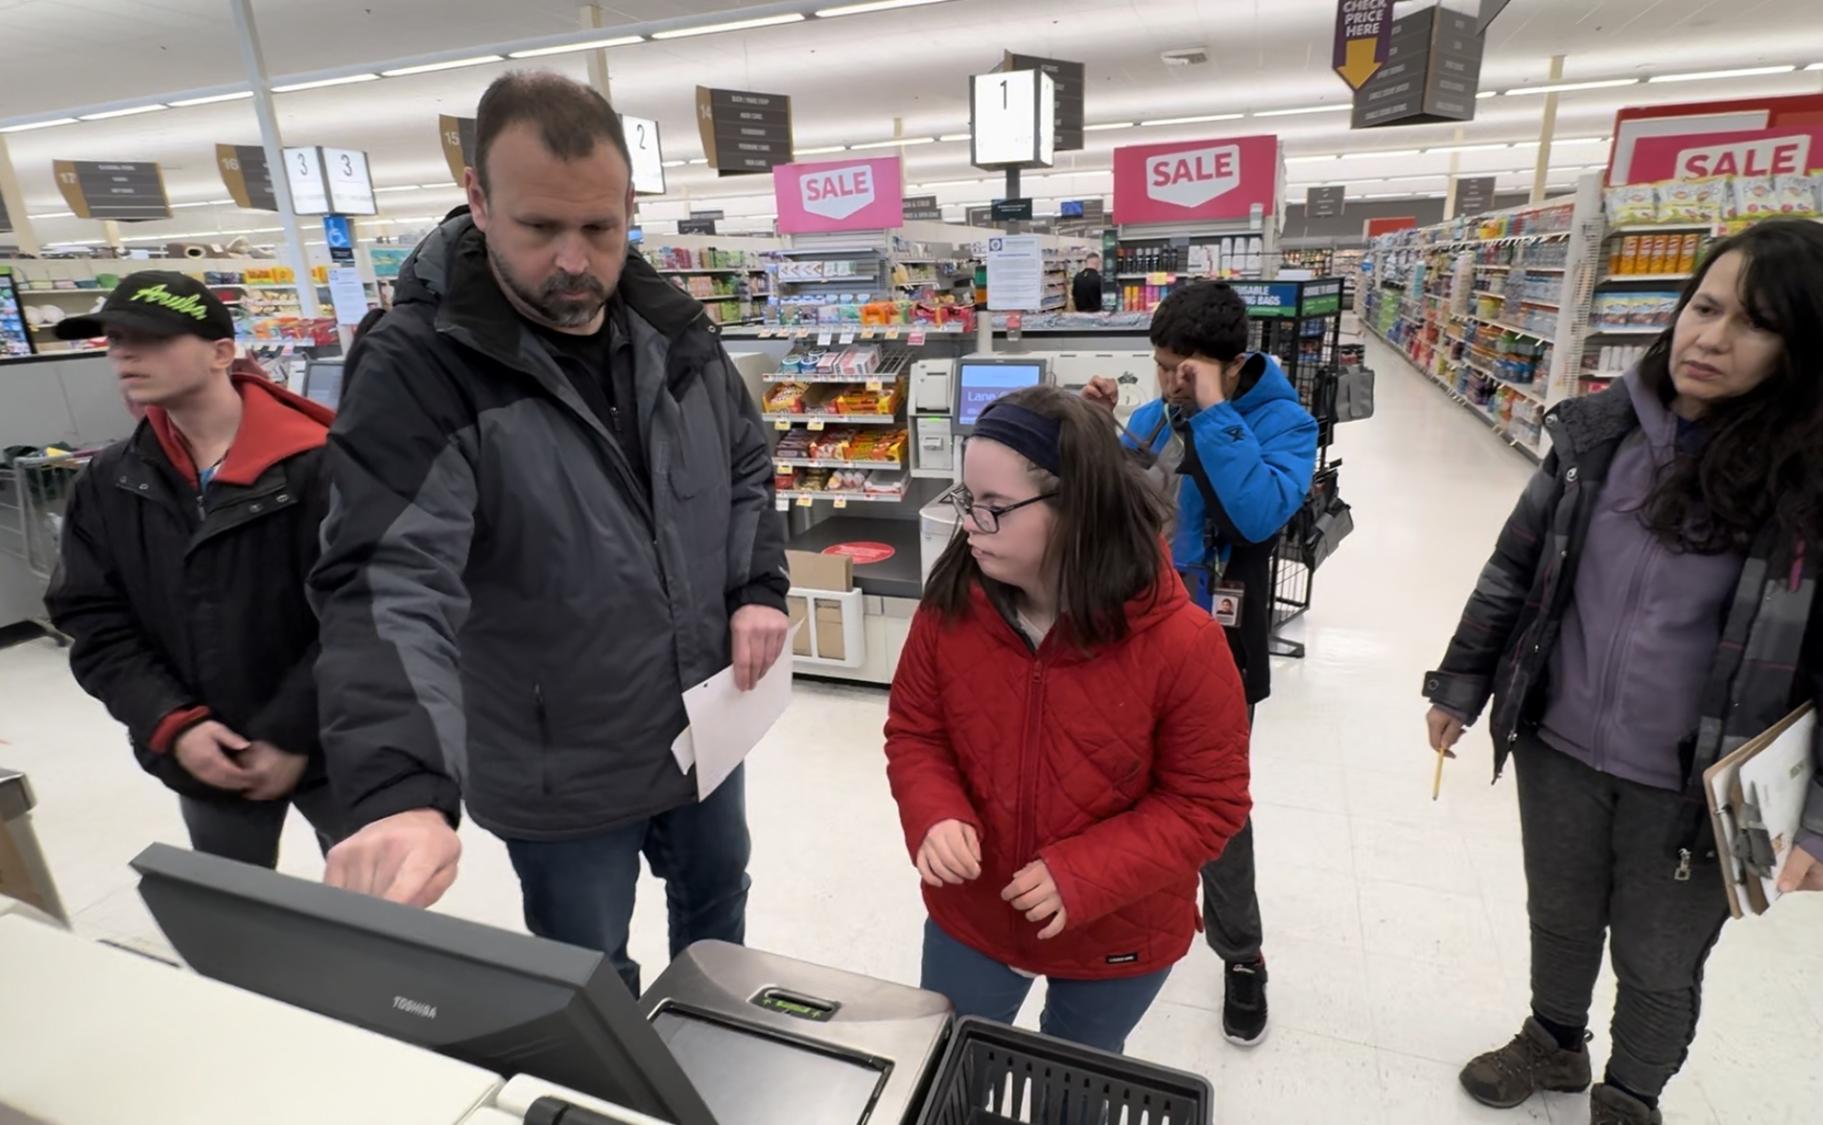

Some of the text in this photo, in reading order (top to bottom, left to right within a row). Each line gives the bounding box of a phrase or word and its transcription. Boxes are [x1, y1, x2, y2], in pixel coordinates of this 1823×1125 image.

[1343, 0, 1388, 13] CHECK
[1344, 9, 1385, 25] PRICE
[1345, 22, 1380, 37] HERE
[1000, 80, 1008, 110] 1
[445, 131, 460, 146] 15
[636, 123, 646, 150] 2
[222, 158, 239, 170] 16
[297, 153, 309, 176] 3
[340, 154, 353, 176] 3
[1152, 152, 1234, 187] SALE
[1684, 143, 1800, 179] SALE
[806, 171, 870, 201] SALE
[1257, 296, 1281, 306] BAGS
[392, 995, 438, 1020] TOSHIBA
